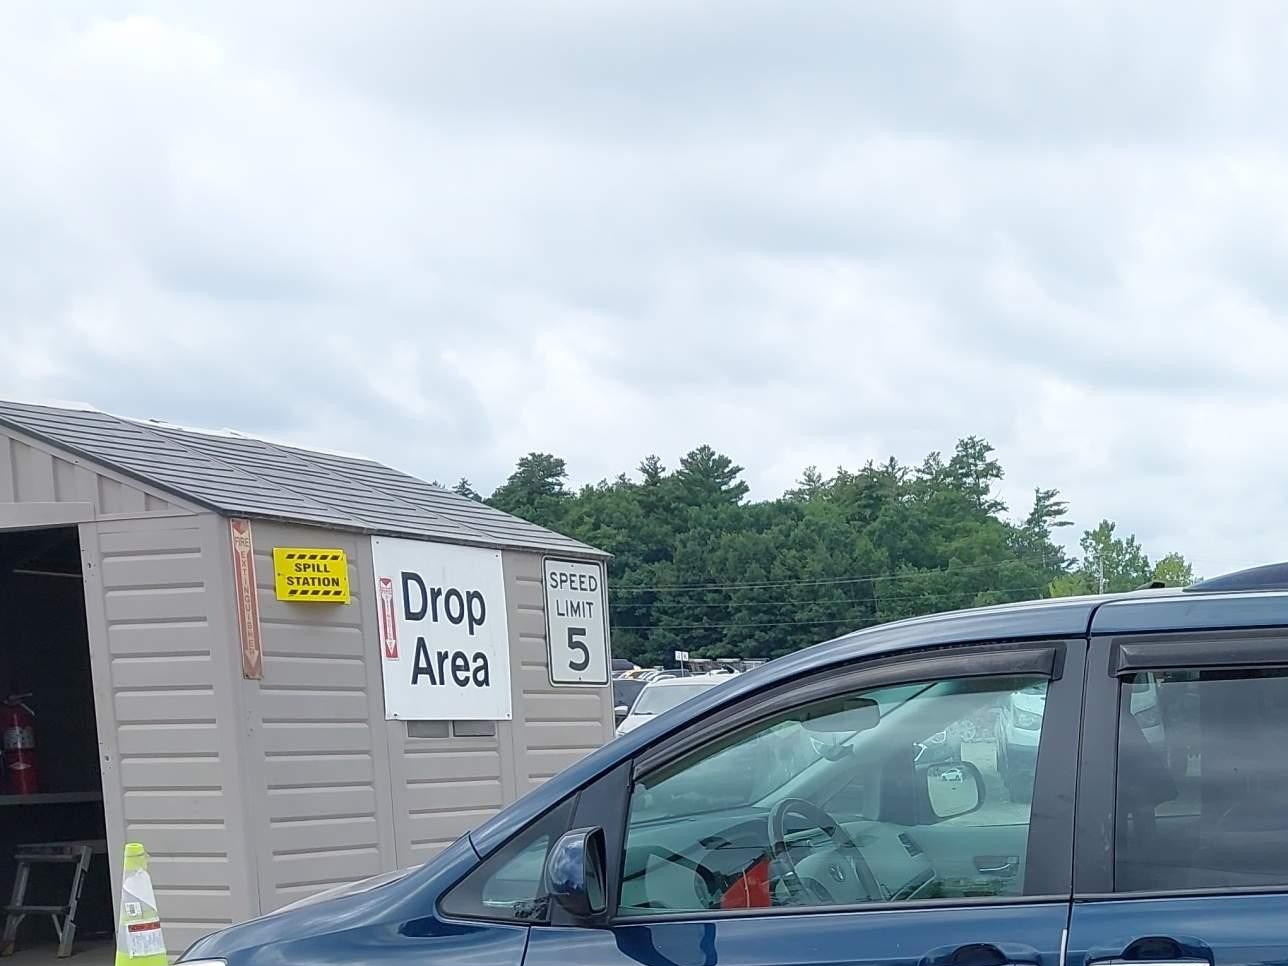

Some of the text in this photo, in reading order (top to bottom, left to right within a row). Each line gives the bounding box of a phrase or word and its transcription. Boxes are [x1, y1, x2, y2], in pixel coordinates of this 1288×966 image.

[294, 562, 331, 574] SPILL
[286, 575, 340, 588] STATION
[549, 571, 598, 592] SPEED
[401, 571, 486, 636] Drop
[555, 599, 594, 618] LIMIT
[567, 626, 590, 672] 5
[410, 636, 490, 688] Area
